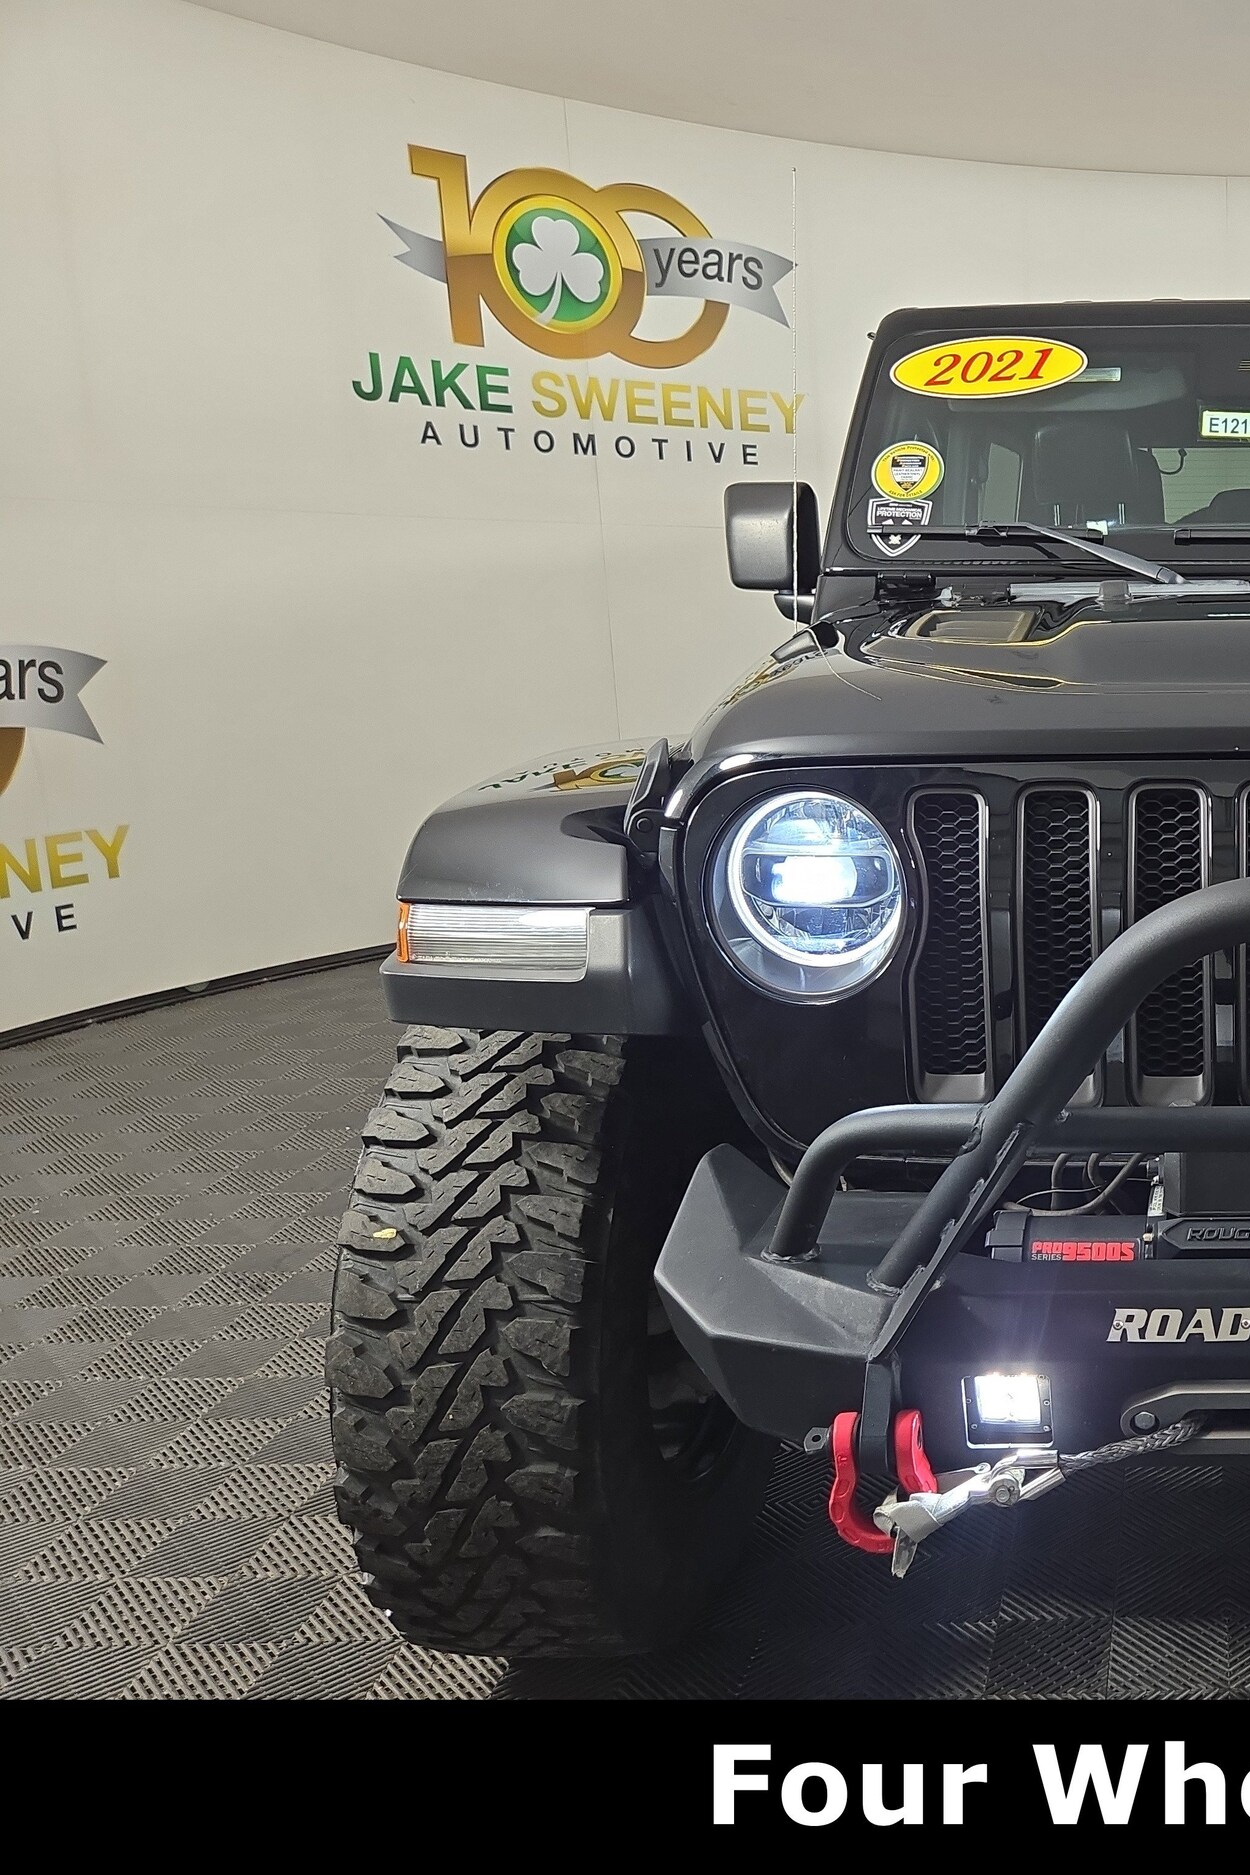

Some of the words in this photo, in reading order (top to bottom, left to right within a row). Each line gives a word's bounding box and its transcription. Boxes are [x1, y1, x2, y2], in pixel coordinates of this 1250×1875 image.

[407, 143, 730, 369] 100
[653, 246, 764, 291] years
[924, 347, 1054, 387] 2021
[352, 352, 513, 414] JAKE
[531, 370, 805, 434] SWEENEY
[420, 421, 759, 466] AUTOMOTIVE
[876, 510, 923, 518] PROTECTION
[1031, 1242, 1063, 1254] PRO
[1062, 1242, 1135, 1261] 9500S
[1031, 1253, 1062, 1261] SERIES
